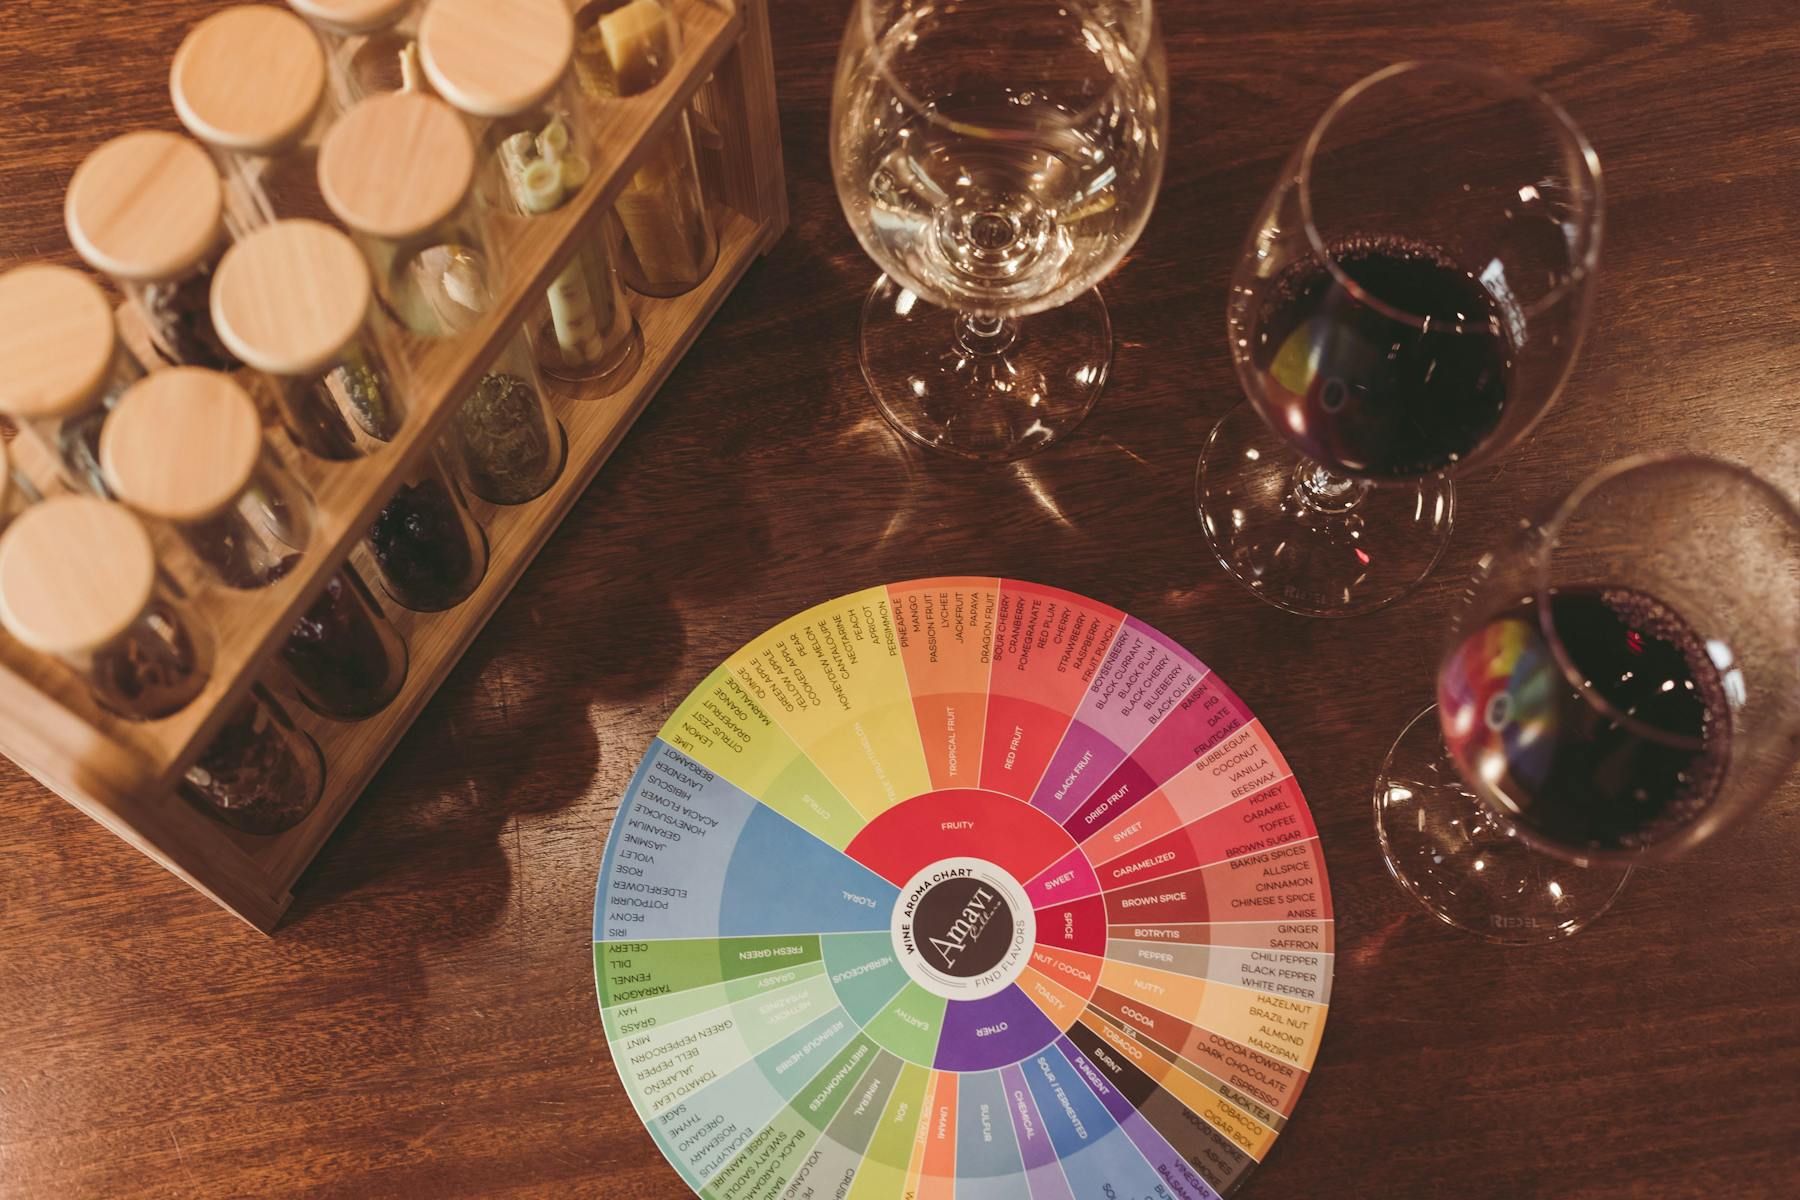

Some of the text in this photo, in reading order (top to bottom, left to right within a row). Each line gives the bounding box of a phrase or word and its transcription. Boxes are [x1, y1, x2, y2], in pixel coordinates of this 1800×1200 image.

[848, 608, 864, 641] PEACH
[893, 598, 909, 648] PINEAPPLE
[909, 595, 921, 632] MANGO
[940, 592, 950, 628] LYCHEE
[955, 592, 965, 644] JACKFRUIT
[970, 592, 979, 627] PAPAYA
[832, 614, 858, 665] NECTARINE
[862, 605, 881, 645] APRICOT
[877, 600, 897, 657] PERSIMMON
[924, 594, 938, 663] PASSION FRUIT
[1009, 596, 1026, 654] CRANBERRY
[1018, 599, 1042, 671] POMEGRANATE
[1053, 607, 1072, 645] CHERRY
[789, 632, 807, 657] PEAR
[818, 618, 850, 680] CANTALOUPE
[1057, 611, 1087, 673] STRAWBERRY
[1073, 617, 1101, 670] RASPBERRY
[803, 625, 852, 711] HONEYDEW MELON
[1091, 629, 1130, 693] BOYSENBERRY
[1096, 638, 1145, 711] BLACK CURRANT
[1118, 645, 1158, 699] BLACK PLUM
[737, 667, 766, 700] QUINCE
[750, 657, 794, 712] GREEN APPLE
[762, 648, 809, 711] YELLOW APPLE
[1143, 664, 1183, 711] BLUEBERRY
[713, 687, 748, 721] ORANGE
[725, 676, 772, 726] MARMALADE
[1181, 684, 1208, 711] RAISIN
[1203, 695, 1219, 711] FIG
[691, 711, 743, 753] CITRUS ZEST
[702, 700, 751, 743] GRAPEFRUIT
[1207, 706, 1230, 728] DATE
[672, 734, 694, 752] LIME
[682, 722, 714, 748] LEMON
[946, 706, 958, 777] TROPICAL FRUIT
[1004, 725, 1024, 770] RED FRUIT
[1194, 718, 1241, 756] FRUITCAKE
[664, 748, 714, 782] BERGAMOT
[1196, 731, 1250, 771] BUBBLEGUM
[1212, 744, 1259, 776] COCONUT
[655, 761, 704, 791] LAVENDER
[1054, 750, 1094, 801] BLACK FRUIT
[1229, 758, 1269, 782] VANILLA
[1231, 771, 1276, 798] BEESWAX
[647, 775, 691, 800] HIBISCUS
[1248, 785, 1283, 805] HONEY
[641, 788, 719, 828] ACACIA FLOWER
[1084, 784, 1130, 824] DRIED FRUIT
[1243, 800, 1290, 824] CARAMEL
[628, 818, 681, 842] GERANIUM
[634, 803, 706, 837] HONEYSUCKLE
[941, 821, 974, 830] FRUITY
[1112, 820, 1143, 843] SWEET
[1259, 815, 1296, 833] TOFFEE
[619, 849, 655, 865] VIOLET
[624, 833, 667, 851] JASMINE
[1225, 830, 1301, 858] BROWN SUGAR
[615, 864, 644, 877] ROSE
[1112, 851, 1176, 878] CARAMELIZED
[1230, 845, 1306, 870] BAKING SPICES
[1262, 861, 1310, 877] ALLSPICE
[613, 880, 688, 898] ELDERFLOWER
[1044, 870, 1076, 890] SWEET
[1255, 877, 1313, 892] CINNAMON
[610, 897, 669, 909] POTPOURRI
[842, 891, 877, 908] FLORAL
[902, 868, 973, 955] WINE AROMA CHART
[1121, 892, 1187, 908] BROWN SPICE
[1231, 893, 1316, 908] CHINESE 5 SPICE
[1287, 909, 1317, 918] ANISE
[609, 913, 645, 922] PEONY
[609, 928, 627, 937] IRIS
[928, 887, 994, 970] Amavi
[1063, 912, 1074, 940] SPICE
[1277, 924, 1319, 934] GINGER
[609, 944, 648, 953] CELERY
[1134, 929, 1180, 938] BOTRYTIS
[1269, 939, 1319, 950] SAFFRON
[610, 960, 631, 968] DILL
[739, 946, 803, 960] FRESH GREEN
[975, 970, 1002, 988] FIND
[1001, 920, 1025, 972] FLAVORS
[1033, 951, 1053, 965] NUT
[1058, 962, 1092, 982] COCOA
[1138, 949, 1174, 962] PEPPER
[1251, 951, 1318, 966] CHILI PEPPER
[611, 973, 651, 985] FENNEL
[832, 956, 893, 984] HERBACEOUS
[1241, 963, 1317, 982] BLACK PEPPER
[613, 984, 671, 1001] TARRAGON
[1241, 977, 1315, 999] WHITE PEPPER
[617, 1007, 637, 1018] HAY
[620, 1017, 656, 1034] GRASS
[894, 1008, 929, 1032] EARTHY
[1120, 1005, 1155, 1029] COCOA
[1249, 1006, 1309, 1031] BRAZIL NUT
[627, 1035, 651, 1050] MINT
[975, 1022, 1008, 1037] OTHER
[1102, 1026, 1143, 1060] TOBACCO
[1121, 1024, 1138, 1039] TEA
[1259, 1025, 1304, 1047] ALMOND
[1094, 1047, 1123, 1074] BURNT
[1197, 1042, 1287, 1093] DARK CHOCOLATE
[1209, 1034, 1294, 1077] COCOA POWDER
[809, 1044, 868, 1112] BRETTANOMYCES
[1074, 1056, 1110, 1096] PUNGENT
[1229, 1074, 1279, 1108] ESPRESSO
[854, 1078, 880, 1116] MINERAL
[1037, 1056, 1056, 1083] SOUR
[1054, 1087, 1088, 1140] FERMENTED
[1218, 1085, 1271, 1122] BLACK TEA
[658, 1103, 687, 1125] SAGE
[668, 1114, 701, 1140] THYME
[980, 1104, 993, 1142] SULFUR
[1014, 1090, 1035, 1141] CHEMICAL
[1217, 1099, 1263, 1136] TOBACCO
[679, 1114, 724, 1152] OREGANO
[690, 1124, 737, 1165] ROSEMARY
[700, 1127, 754, 1178] EUCALYPTUS
[786, 1150, 822, 1198] VOLCANIC
